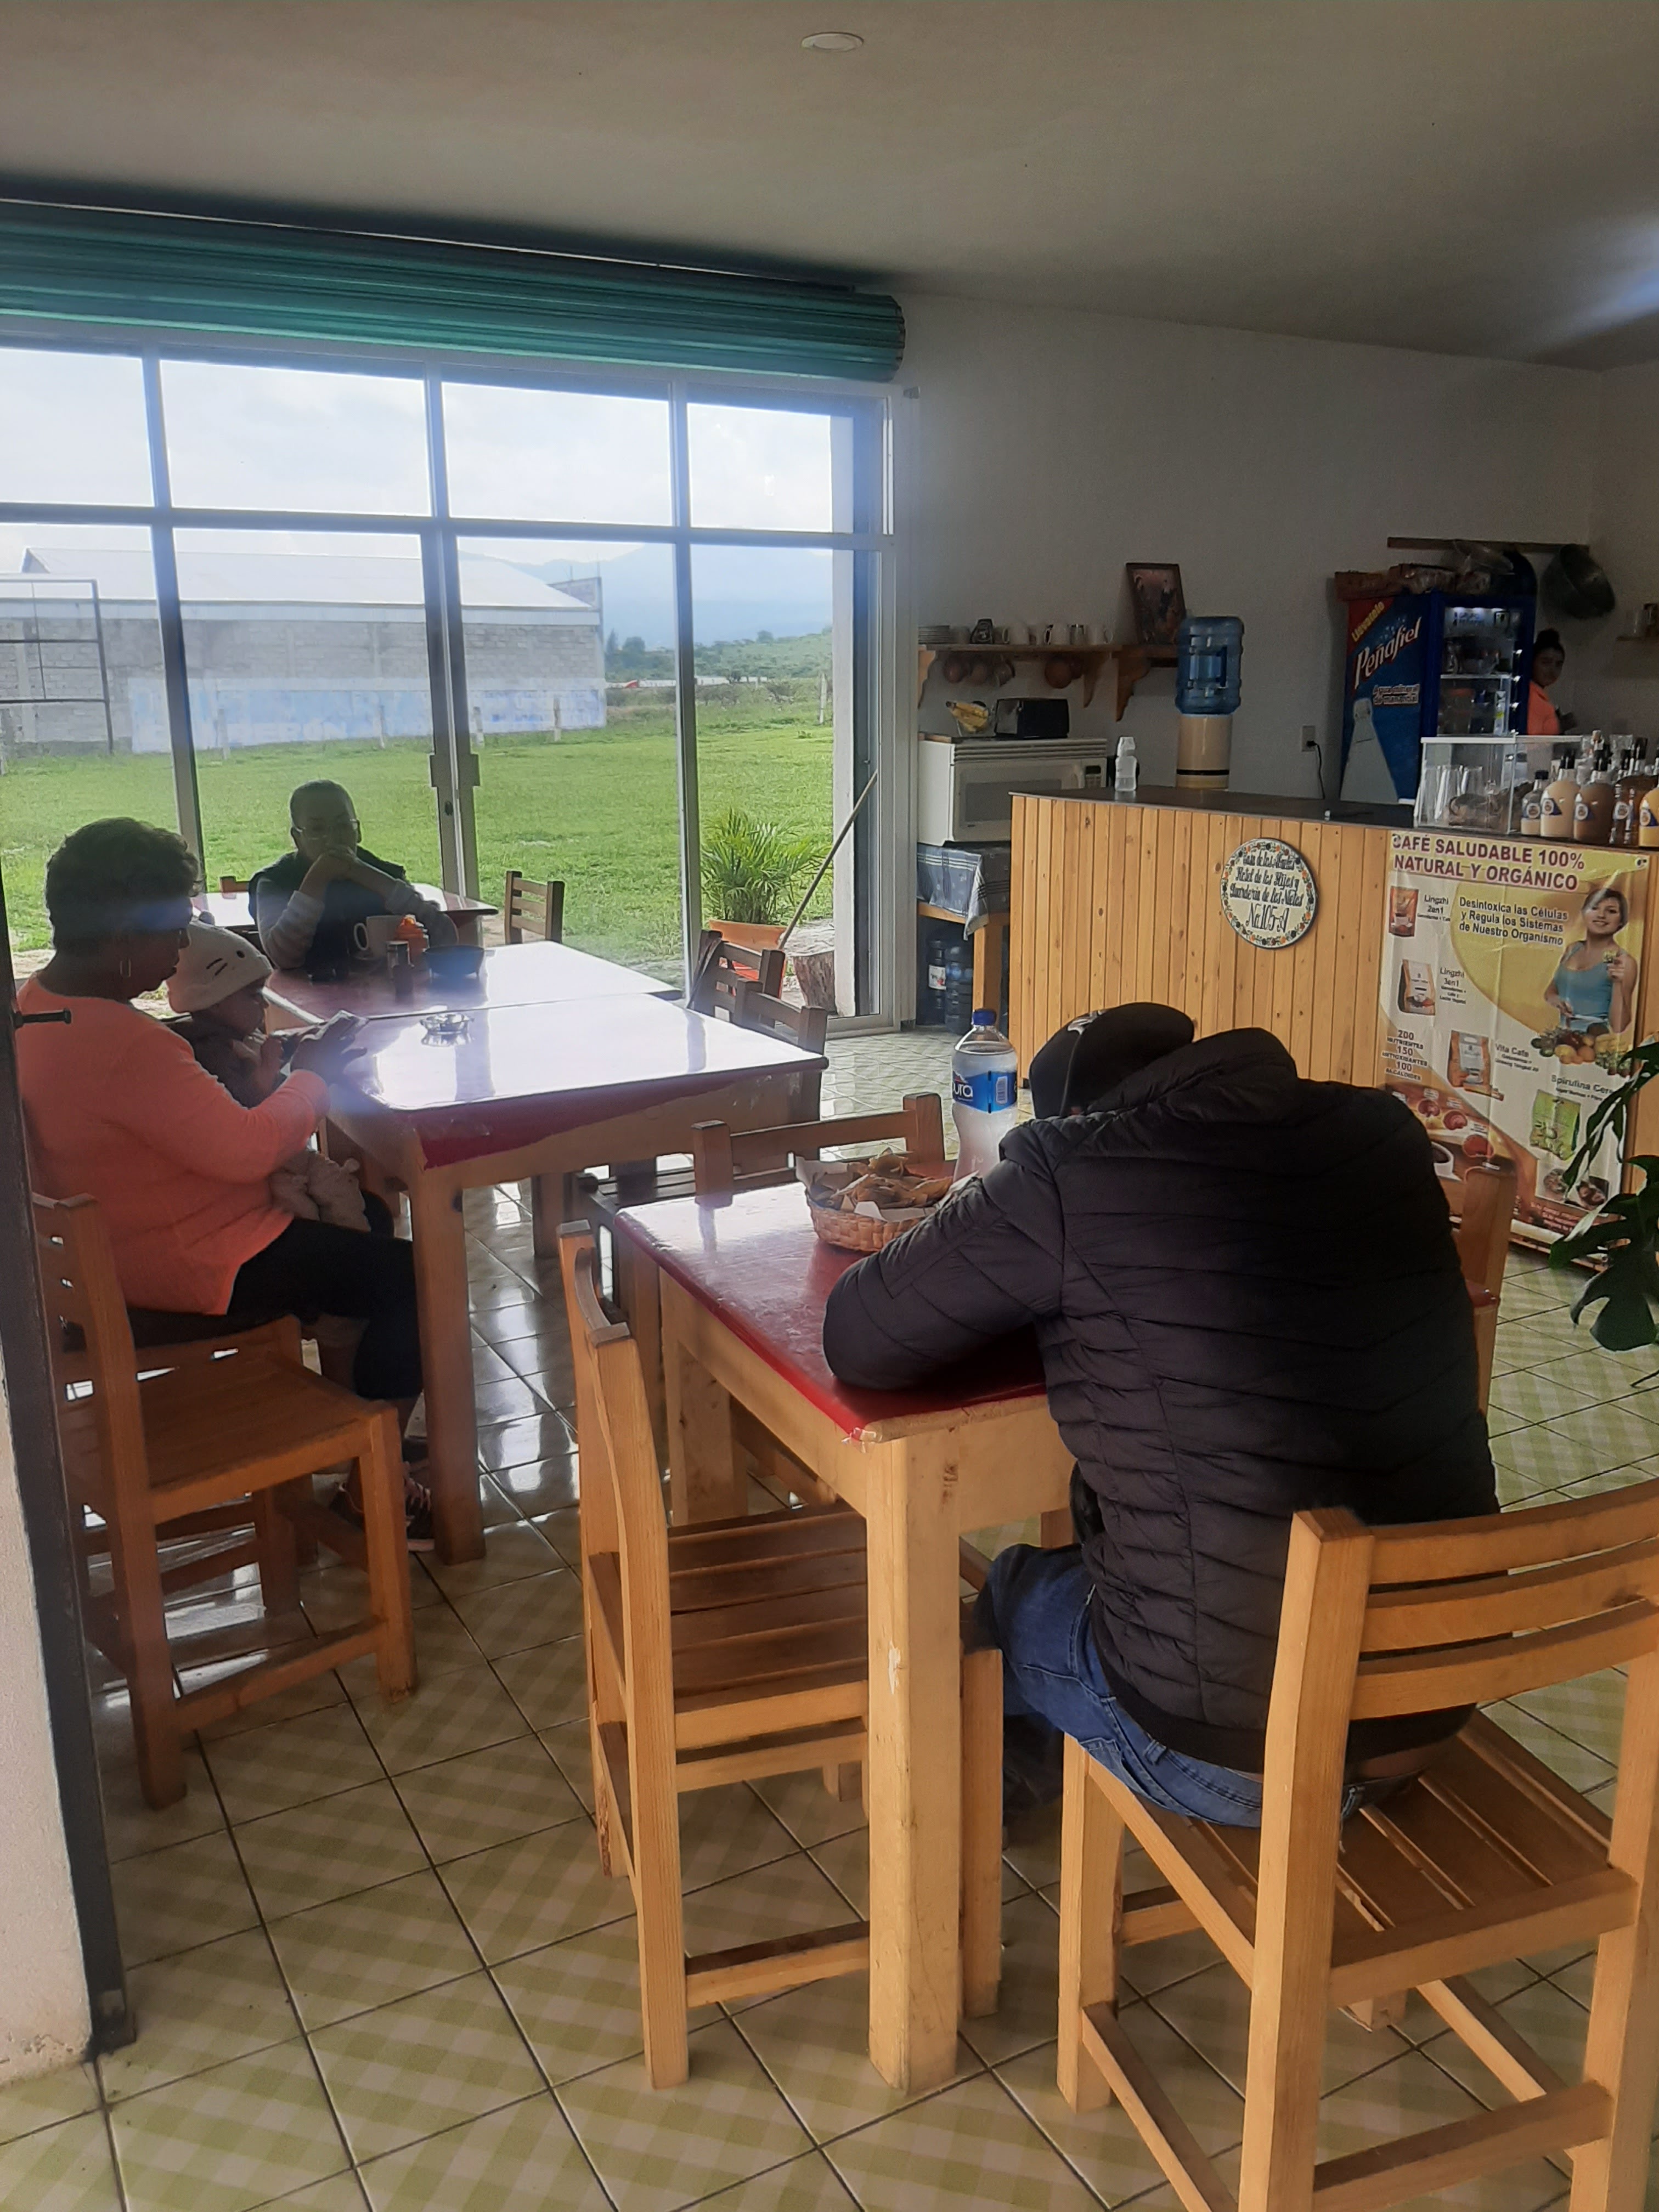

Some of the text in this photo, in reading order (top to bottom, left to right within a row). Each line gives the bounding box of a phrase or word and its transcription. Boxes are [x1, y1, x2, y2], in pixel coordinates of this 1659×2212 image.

[1354, 616, 1422, 690] Peñafiel
[1392, 834, 1585, 870] CAFÉ SALUDABLE 100%
[1394, 854, 1578, 890] NATURAL Y ORGÁNICO
[1459, 896, 1567, 919] Desintoxica las Células
[1462, 911, 1466, 920] y
[1469, 910, 1499, 924] Regula
[1503, 915, 1516, 926] los
[1520, 917, 1564, 932] Sistemas
[1459, 922, 1564, 945] de Nuestro Organismo
[1398, 1029, 1414, 1041] 200
[1397, 1045, 1413, 1056] 150
[1397, 1061, 1412, 1071] 100
[952, 1082, 973, 1097] ura
[1551, 1074, 1590, 1090] Spirulina
